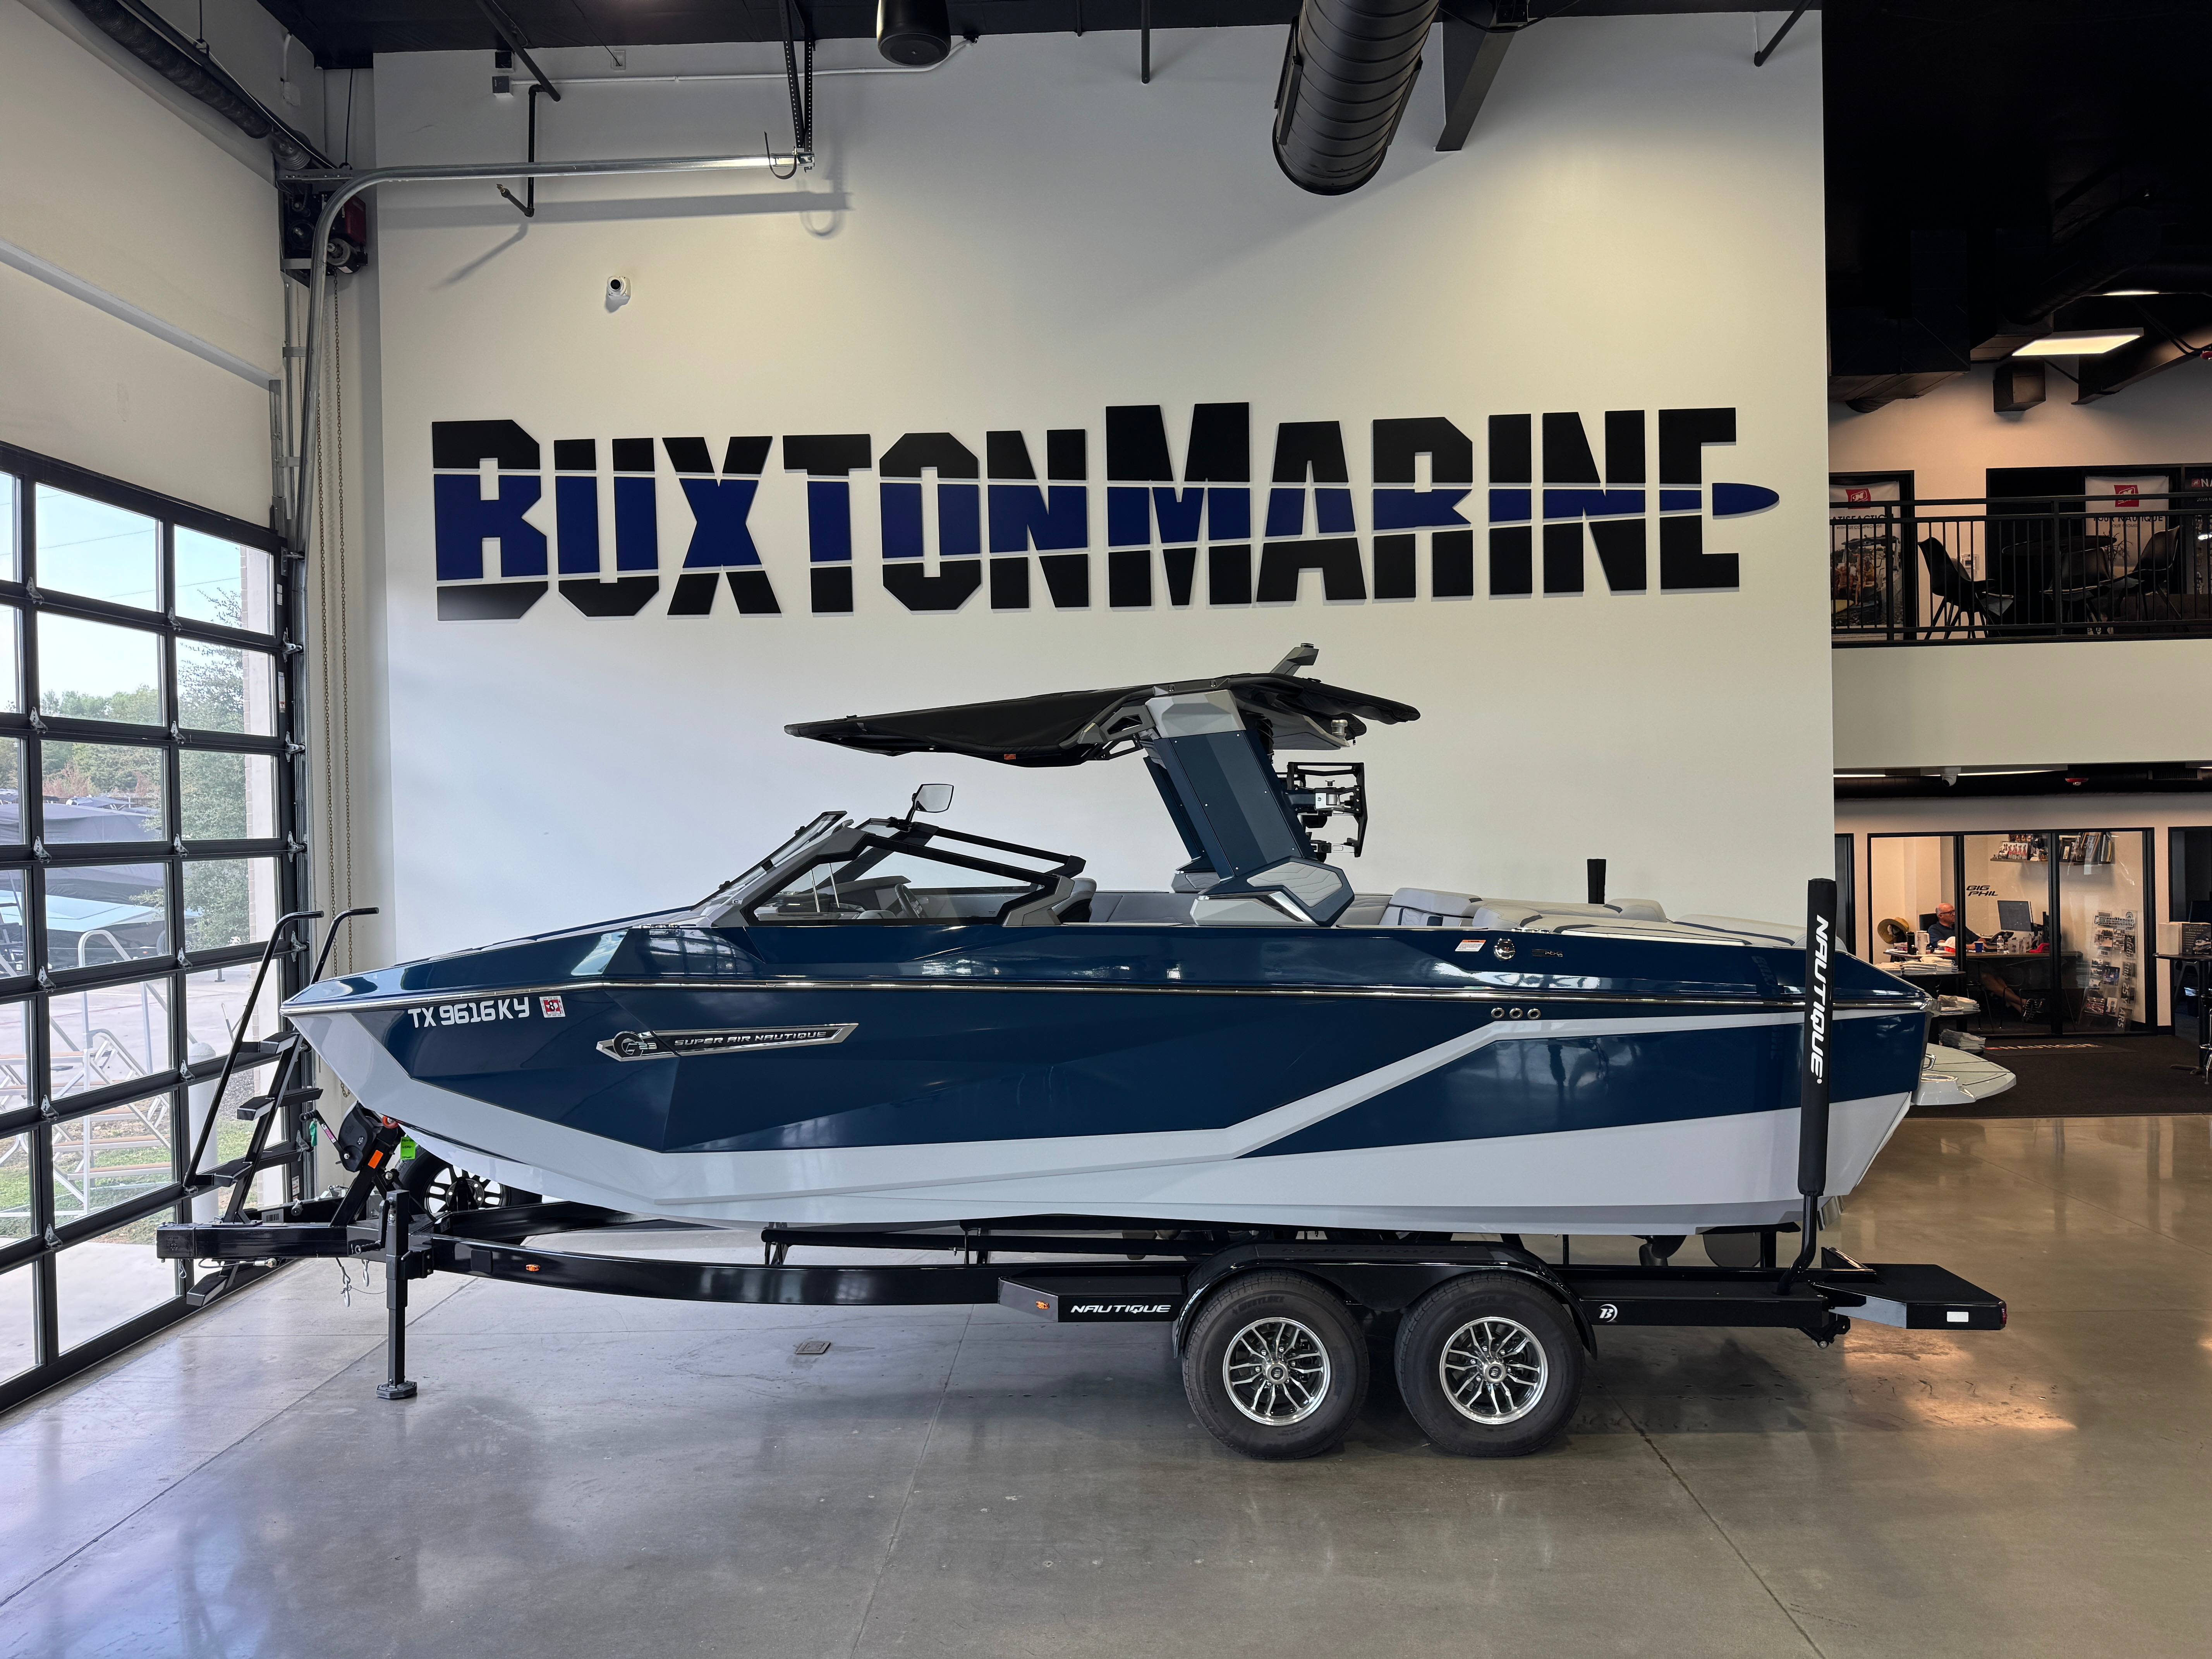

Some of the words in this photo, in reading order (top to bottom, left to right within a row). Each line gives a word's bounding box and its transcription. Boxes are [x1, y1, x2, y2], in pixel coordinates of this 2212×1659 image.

[1811, 914, 1829, 1078] NAUTIQUE
[408, 1007, 436, 1028] TX
[674, 1037, 722, 1046] SUPER
[755, 1031, 827, 1041] NAUTIQUE
[1070, 1305, 1171, 1314] NAUTIQUE
